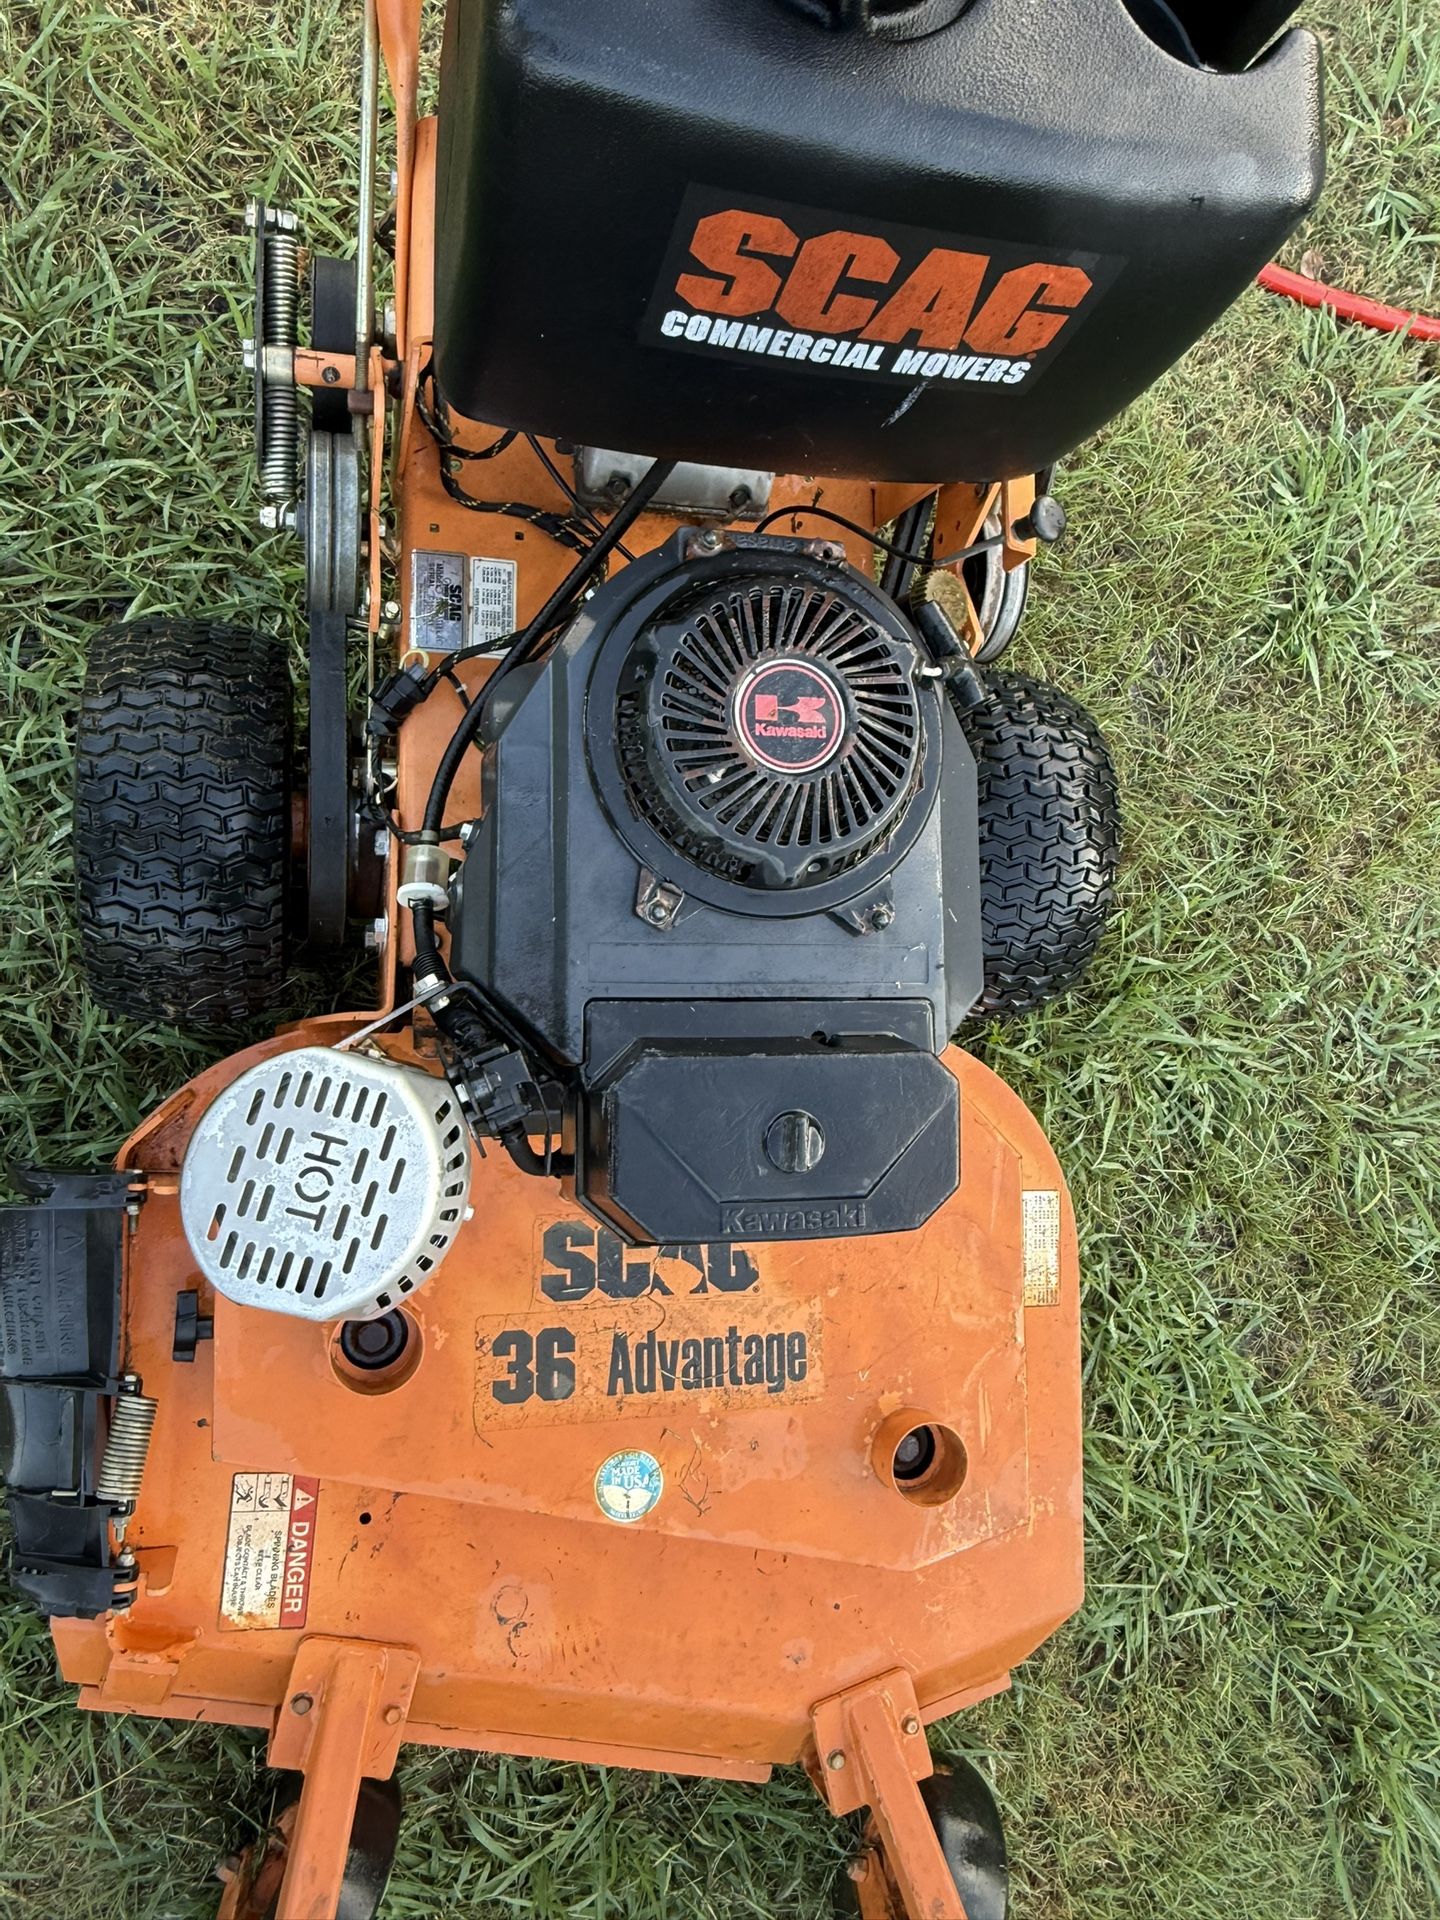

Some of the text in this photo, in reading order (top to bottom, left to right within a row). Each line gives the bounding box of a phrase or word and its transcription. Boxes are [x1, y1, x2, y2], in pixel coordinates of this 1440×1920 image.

[674, 208, 1094, 358] SCAG
[660, 309, 1033, 385] COMMERCIAL MOWERS
[449, 584, 462, 622] SCAG
[755, 722, 827, 739] Kawasaki
[285, 1131, 348, 1232] HOT
[721, 1203, 866, 1234] Kawasaki
[491, 1325, 808, 1405] 36 Advantage
[267, 1530, 282, 1608] SPINNING BLADES
[284, 1521, 310, 1613] DANGER
